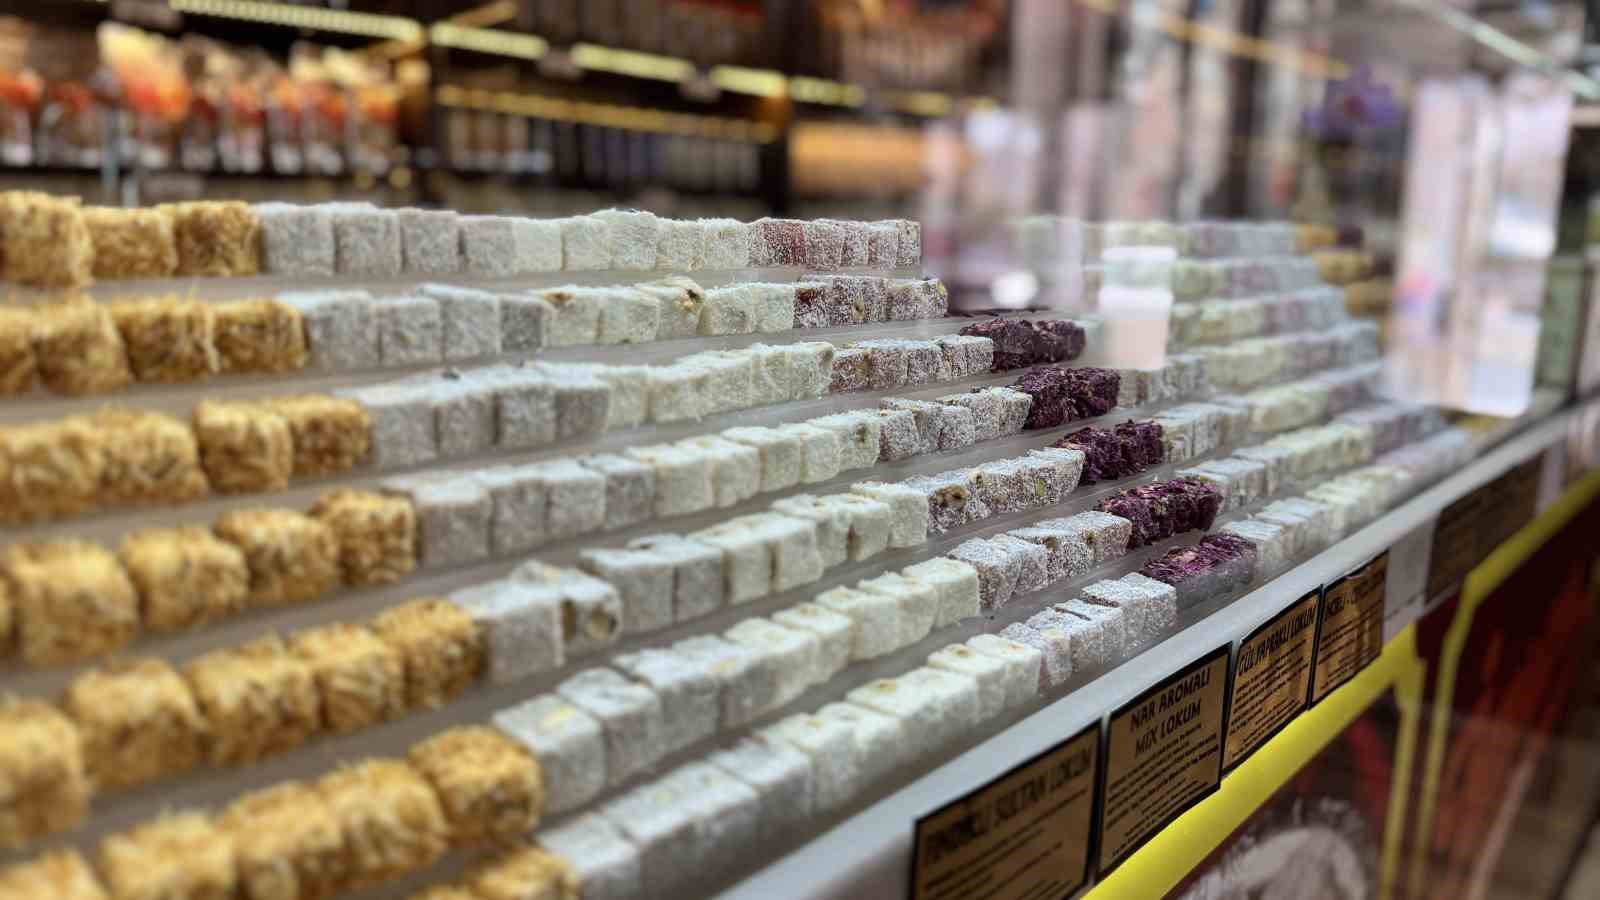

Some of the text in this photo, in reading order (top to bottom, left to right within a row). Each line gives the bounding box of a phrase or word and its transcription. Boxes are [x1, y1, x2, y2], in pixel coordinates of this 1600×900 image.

[1130, 667, 1211, 732] NAR AROMALI
[1161, 698, 1202, 739] LOKUM
